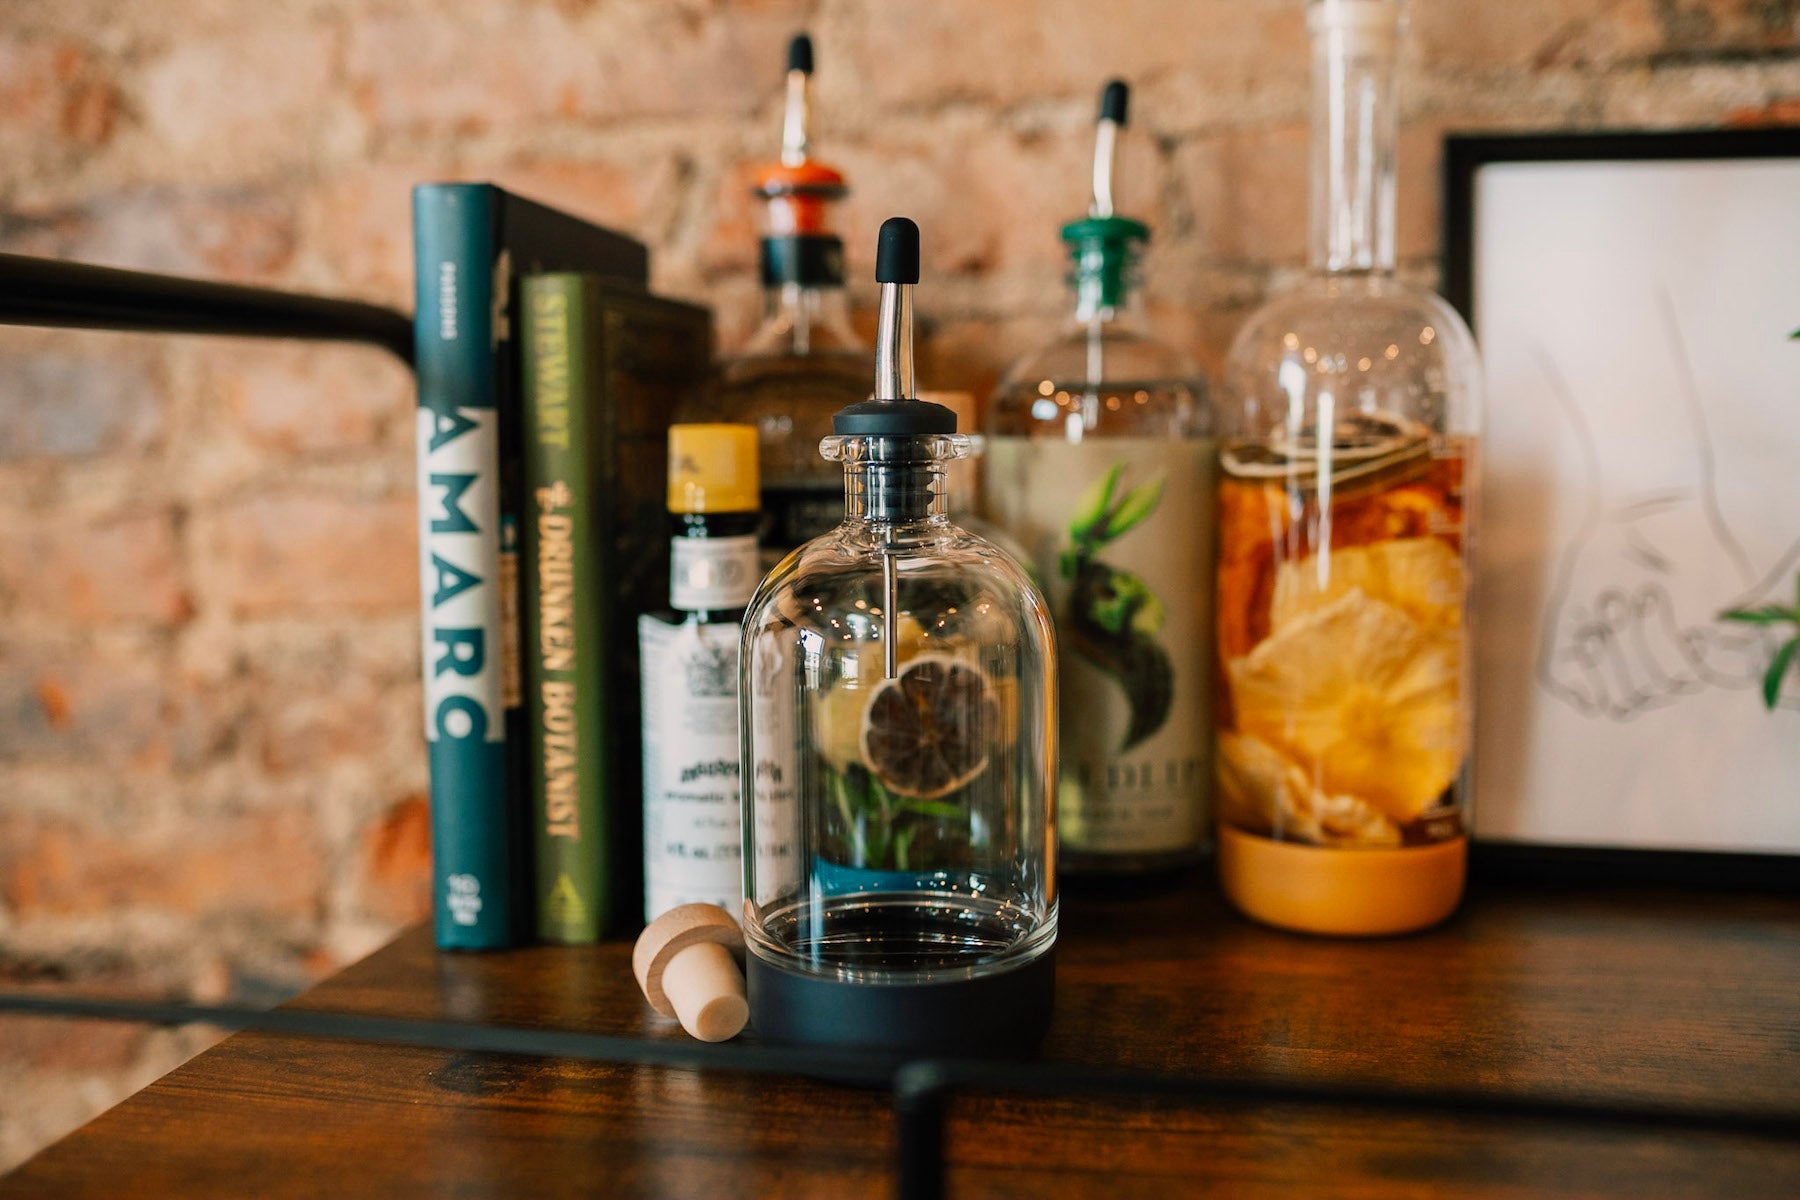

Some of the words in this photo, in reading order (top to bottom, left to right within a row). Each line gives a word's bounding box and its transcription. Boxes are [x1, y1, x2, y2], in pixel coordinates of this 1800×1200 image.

[534, 292, 568, 449] STEWART
[537, 513, 576, 672] DRUNKEN
[542, 680, 580, 844] BOTANIST
